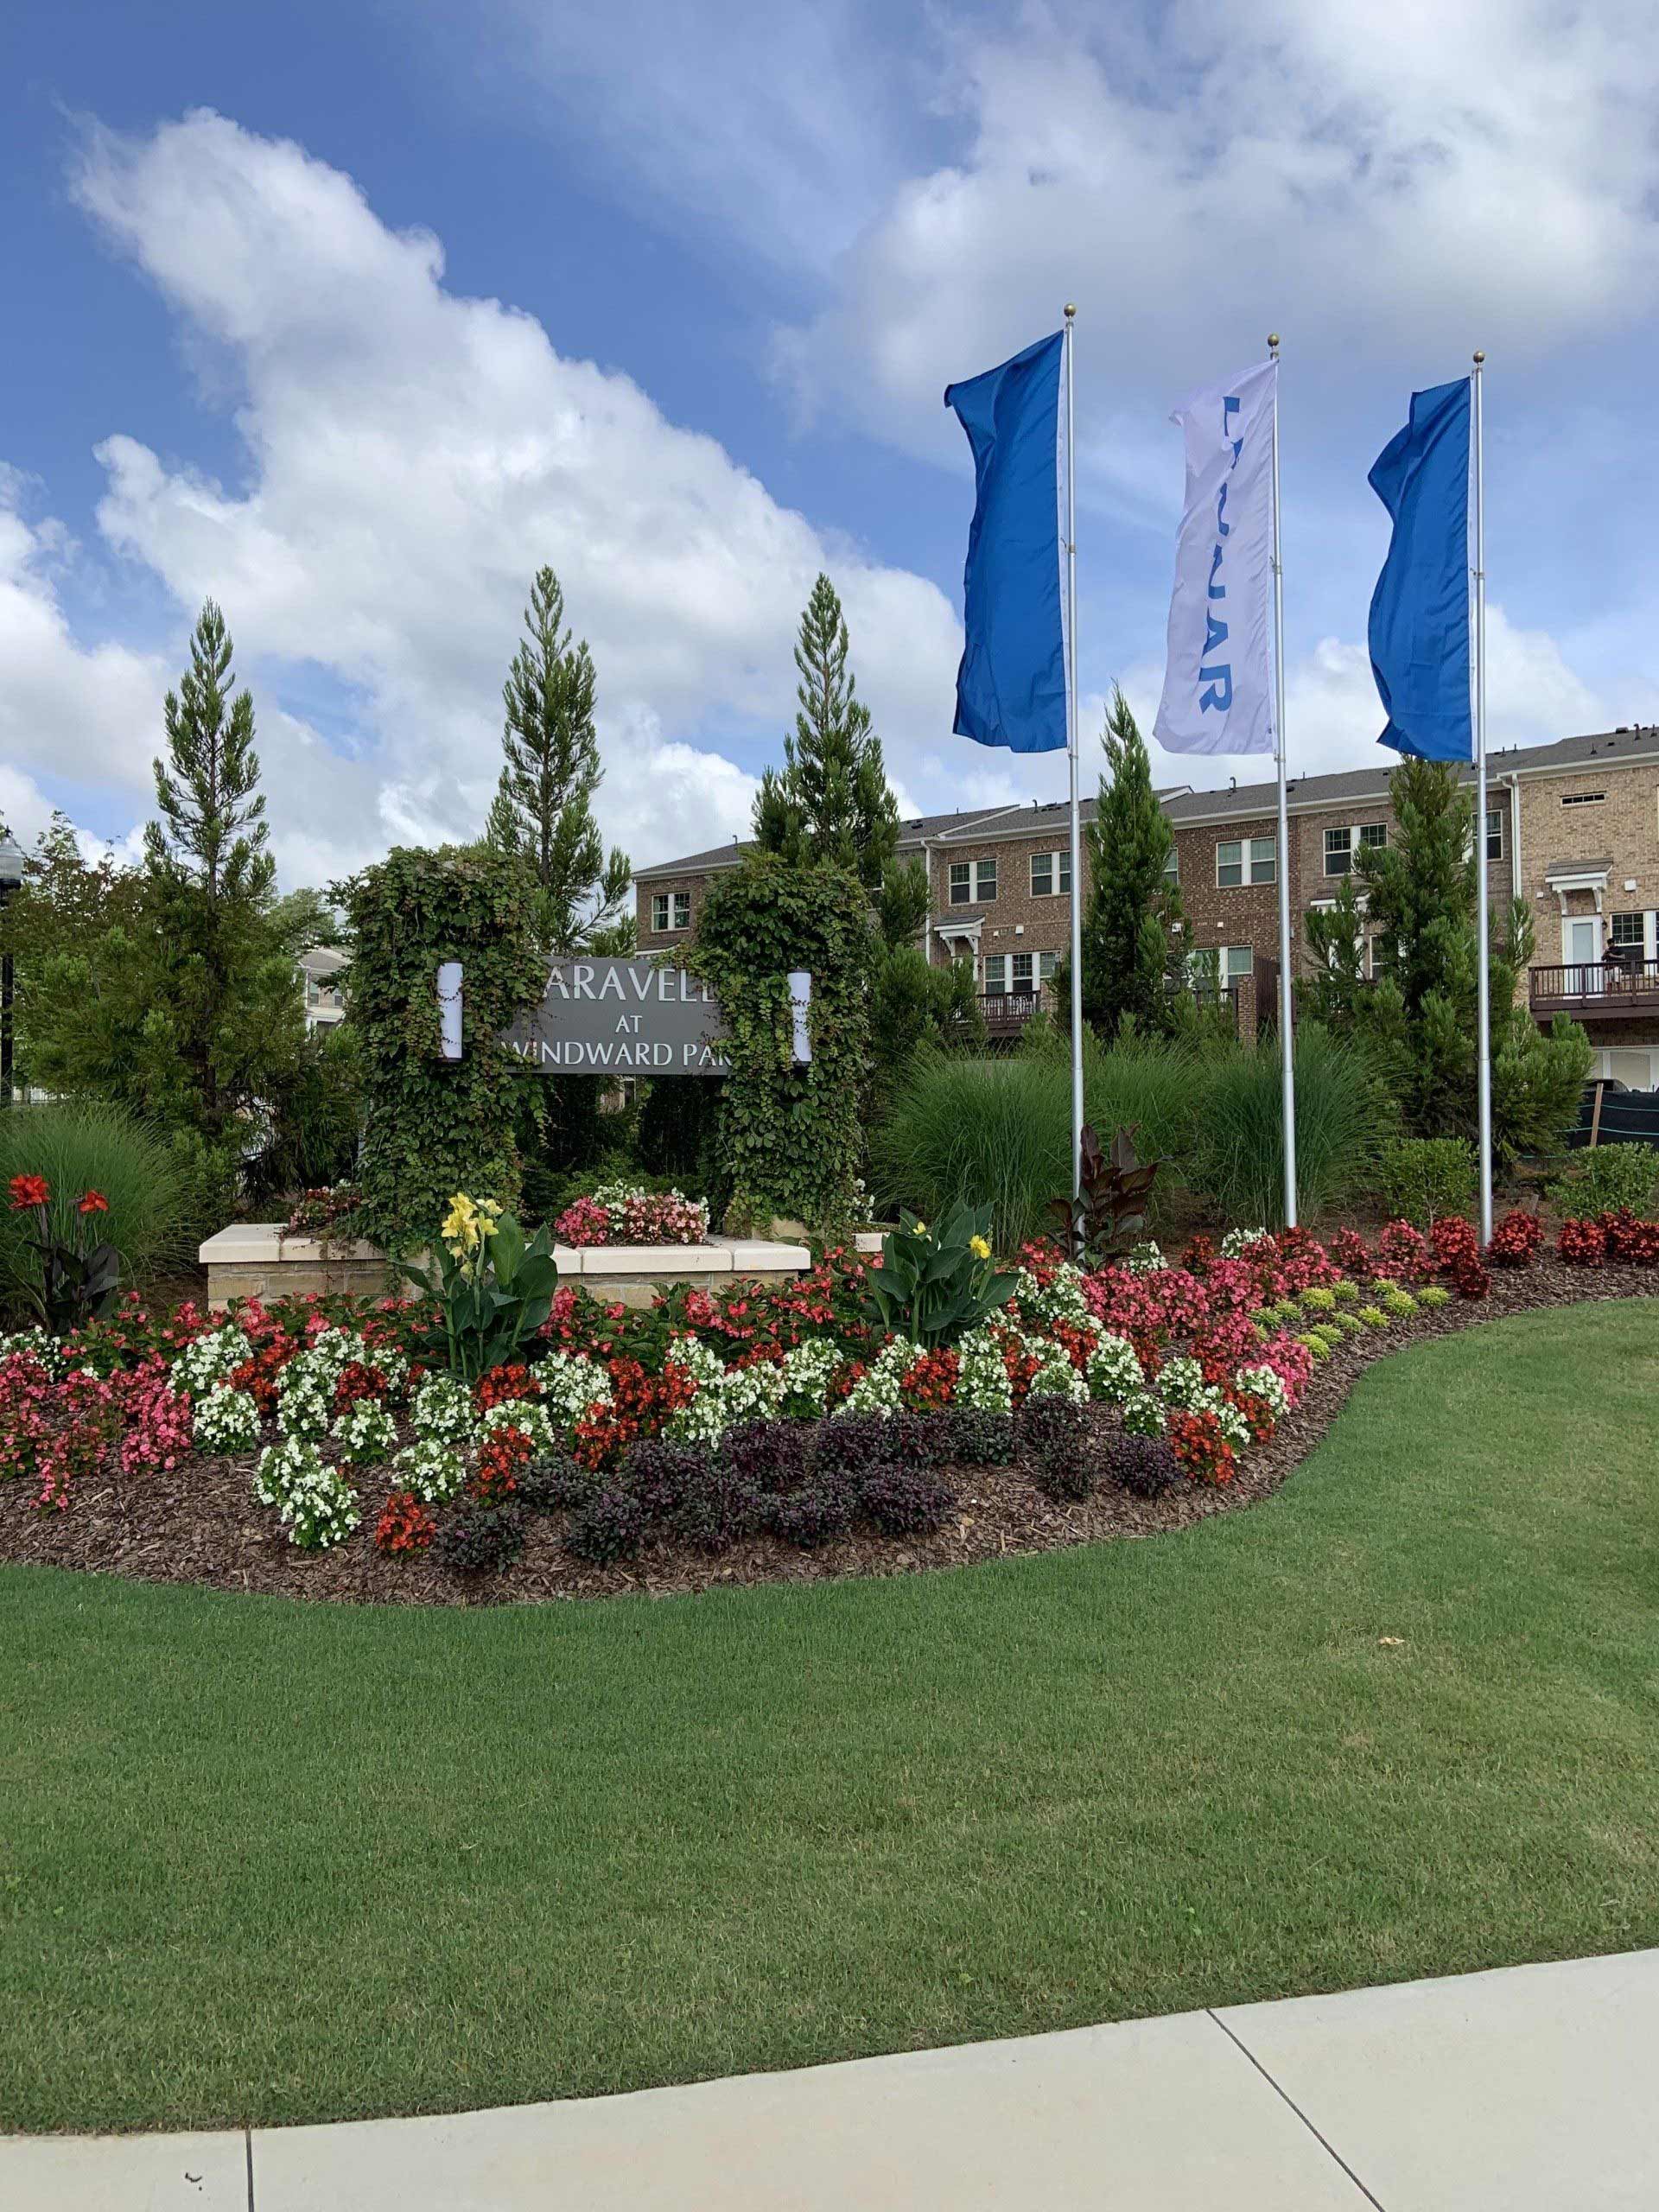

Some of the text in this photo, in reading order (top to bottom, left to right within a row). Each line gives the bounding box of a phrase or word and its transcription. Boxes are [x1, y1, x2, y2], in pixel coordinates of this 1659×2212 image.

[541, 965, 718, 1002] ARAVELL
[615, 1014, 643, 1033] AT
[500, 1041, 733, 1066] WINDWARD PA
